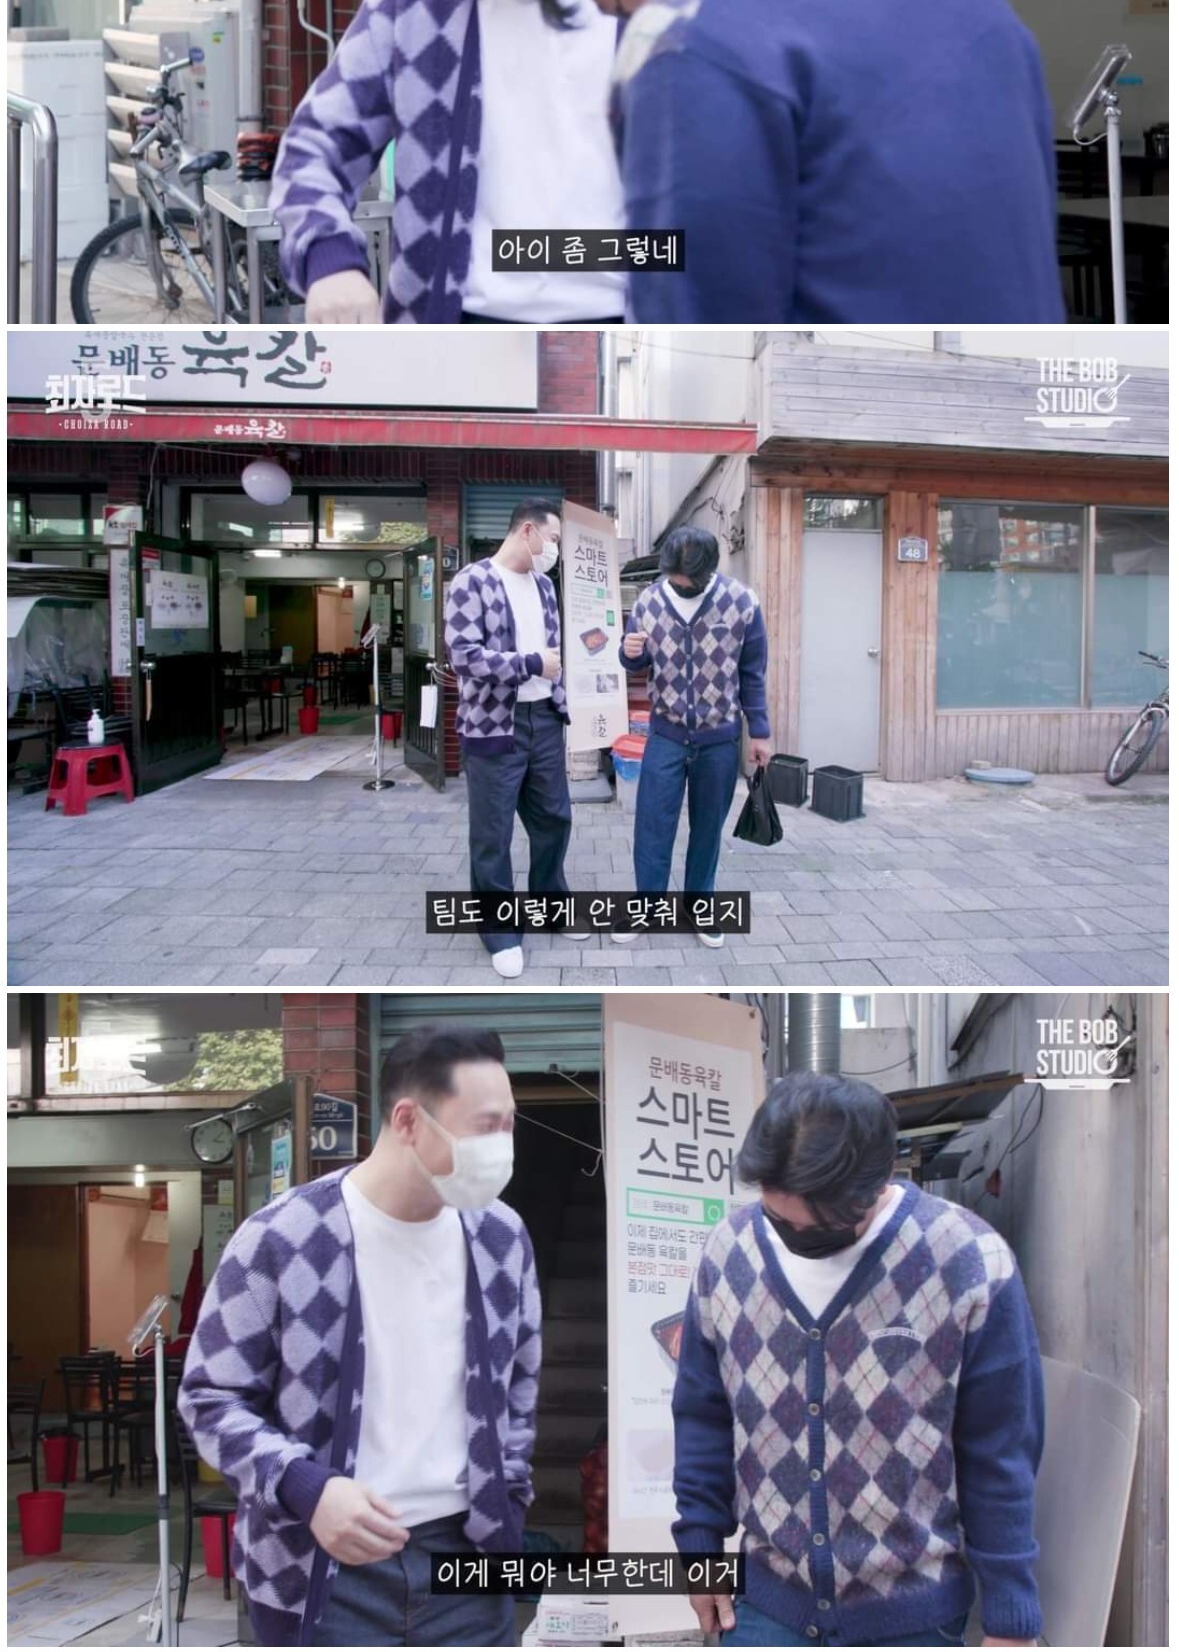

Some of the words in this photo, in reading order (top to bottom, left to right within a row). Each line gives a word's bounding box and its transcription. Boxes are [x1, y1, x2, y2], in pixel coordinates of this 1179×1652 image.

[71, 344, 176, 379] 문배동
[575, 547, 608, 568] 스마트
[905, 548, 920, 558] 48
[575, 565, 609, 589] 스토어
[648, 1056, 722, 1091] 문배동육칼
[636, 1086, 735, 1140] 스마트
[637, 1138, 734, 1195] 스토어
